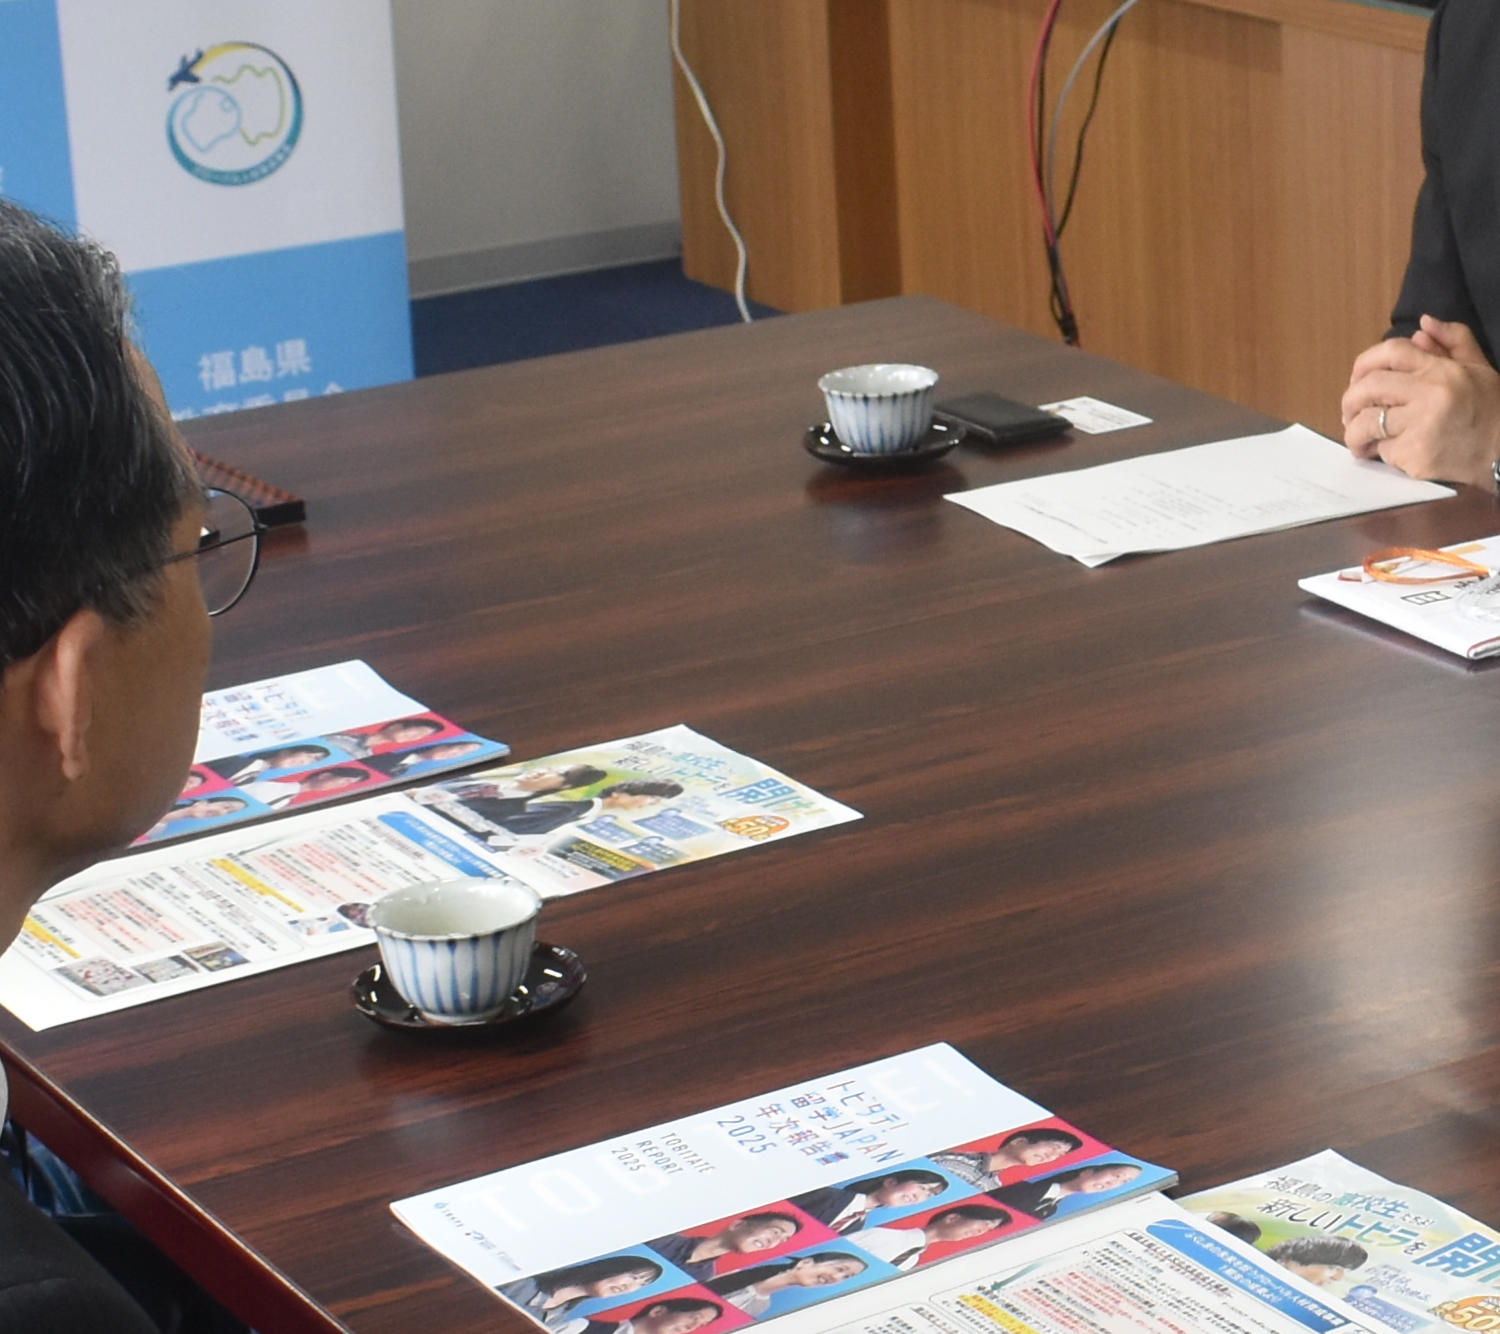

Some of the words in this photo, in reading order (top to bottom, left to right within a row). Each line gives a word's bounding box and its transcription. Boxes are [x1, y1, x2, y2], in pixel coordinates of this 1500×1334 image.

[198, 339, 313, 392] 福島県
[791, 1092, 905, 1163] 留学JAPAN
[827, 1080, 909, 1131] トビタテ!
[636, 1140, 683, 1174] REPORT
[660, 1133, 715, 1174] TOBITATE
[716, 1115, 777, 1155] 2025
[756, 1103, 850, 1165] 年次報告書
[611, 1147, 646, 1172] 2025
